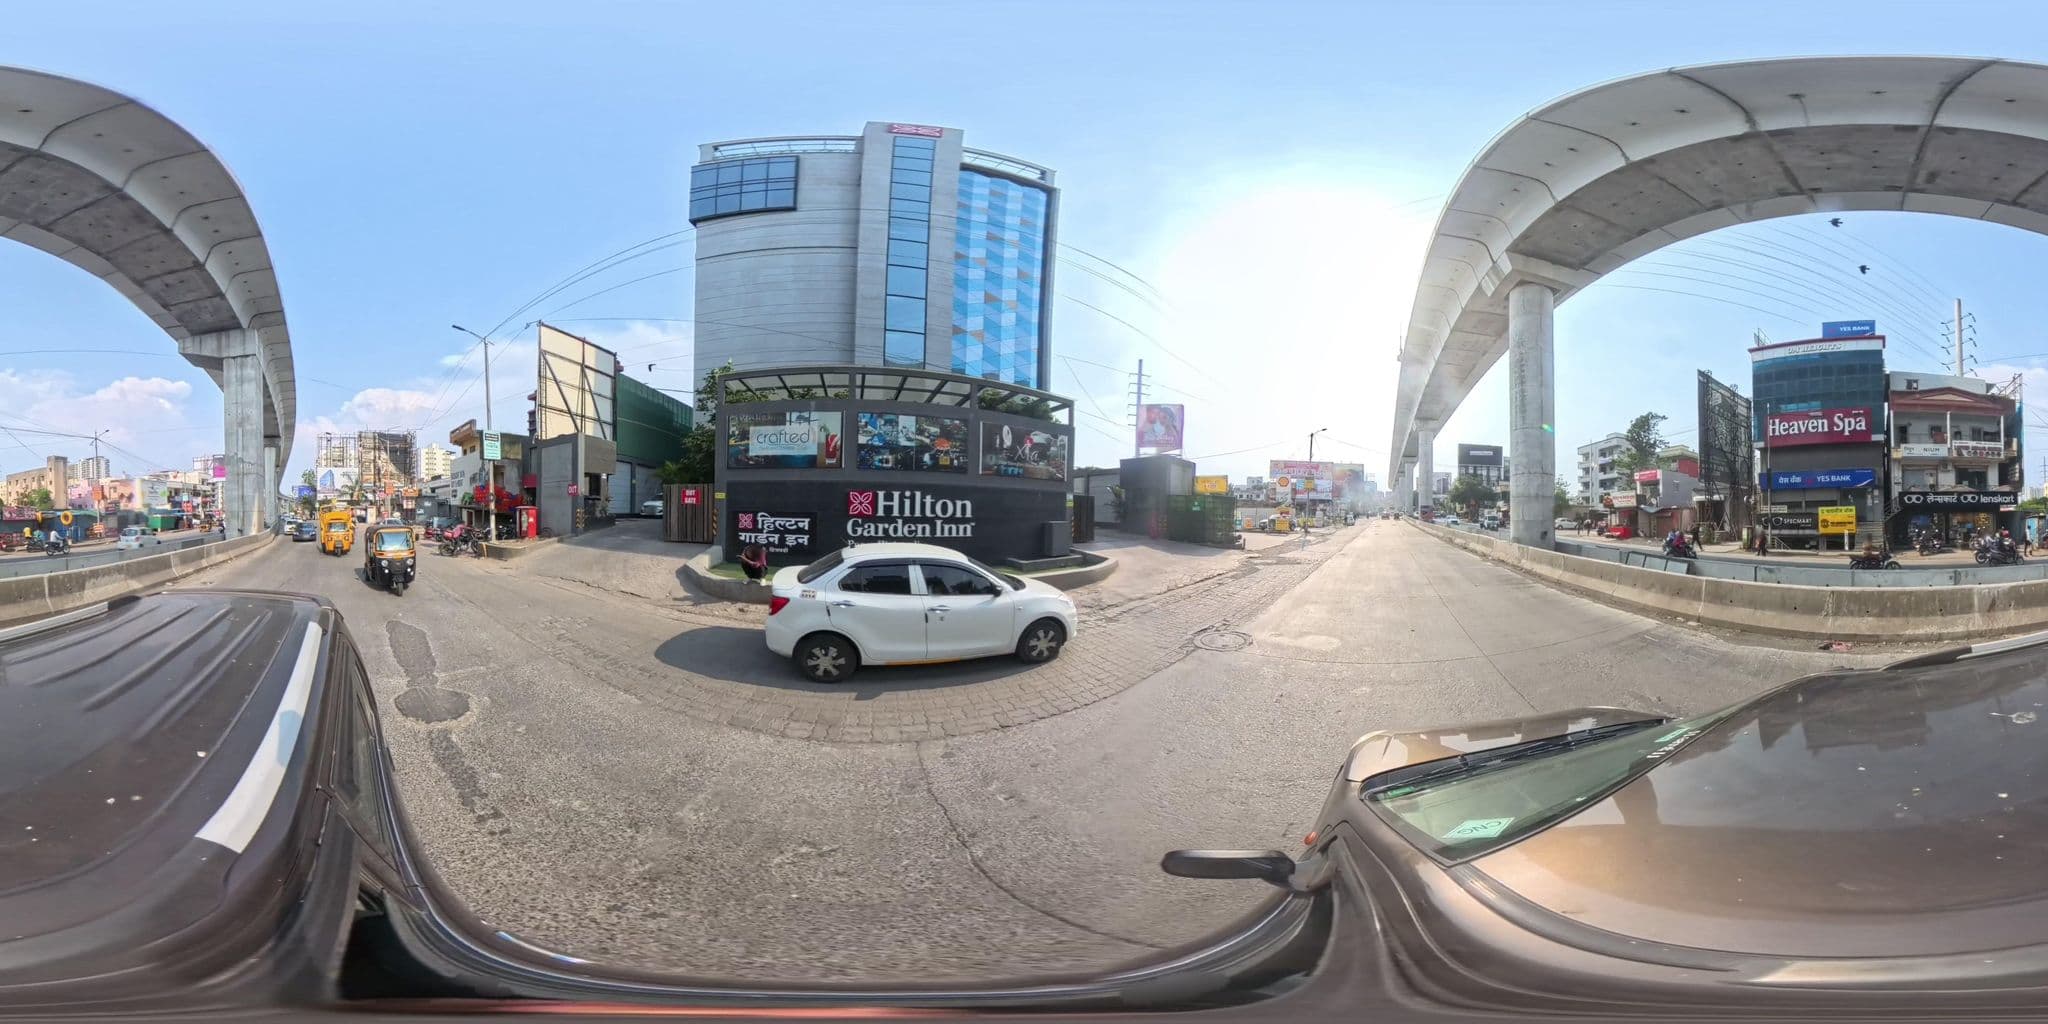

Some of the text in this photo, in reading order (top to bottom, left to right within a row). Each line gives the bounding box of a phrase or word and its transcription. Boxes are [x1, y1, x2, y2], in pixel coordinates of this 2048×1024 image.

[1769, 413, 1867, 436] Heaven Spa
[756, 430, 810, 445] crafted
[568, 485, 577, 494] OUT
[876, 490, 973, 518] Hilton
[1980, 494, 2015, 503] lenskart
[757, 512, 811, 531] हिल्टन
[846, 517, 973, 538] Garden Inn
[738, 530, 810, 547] गार्डन इन
[1457, 819, 1503, 836] CNG
